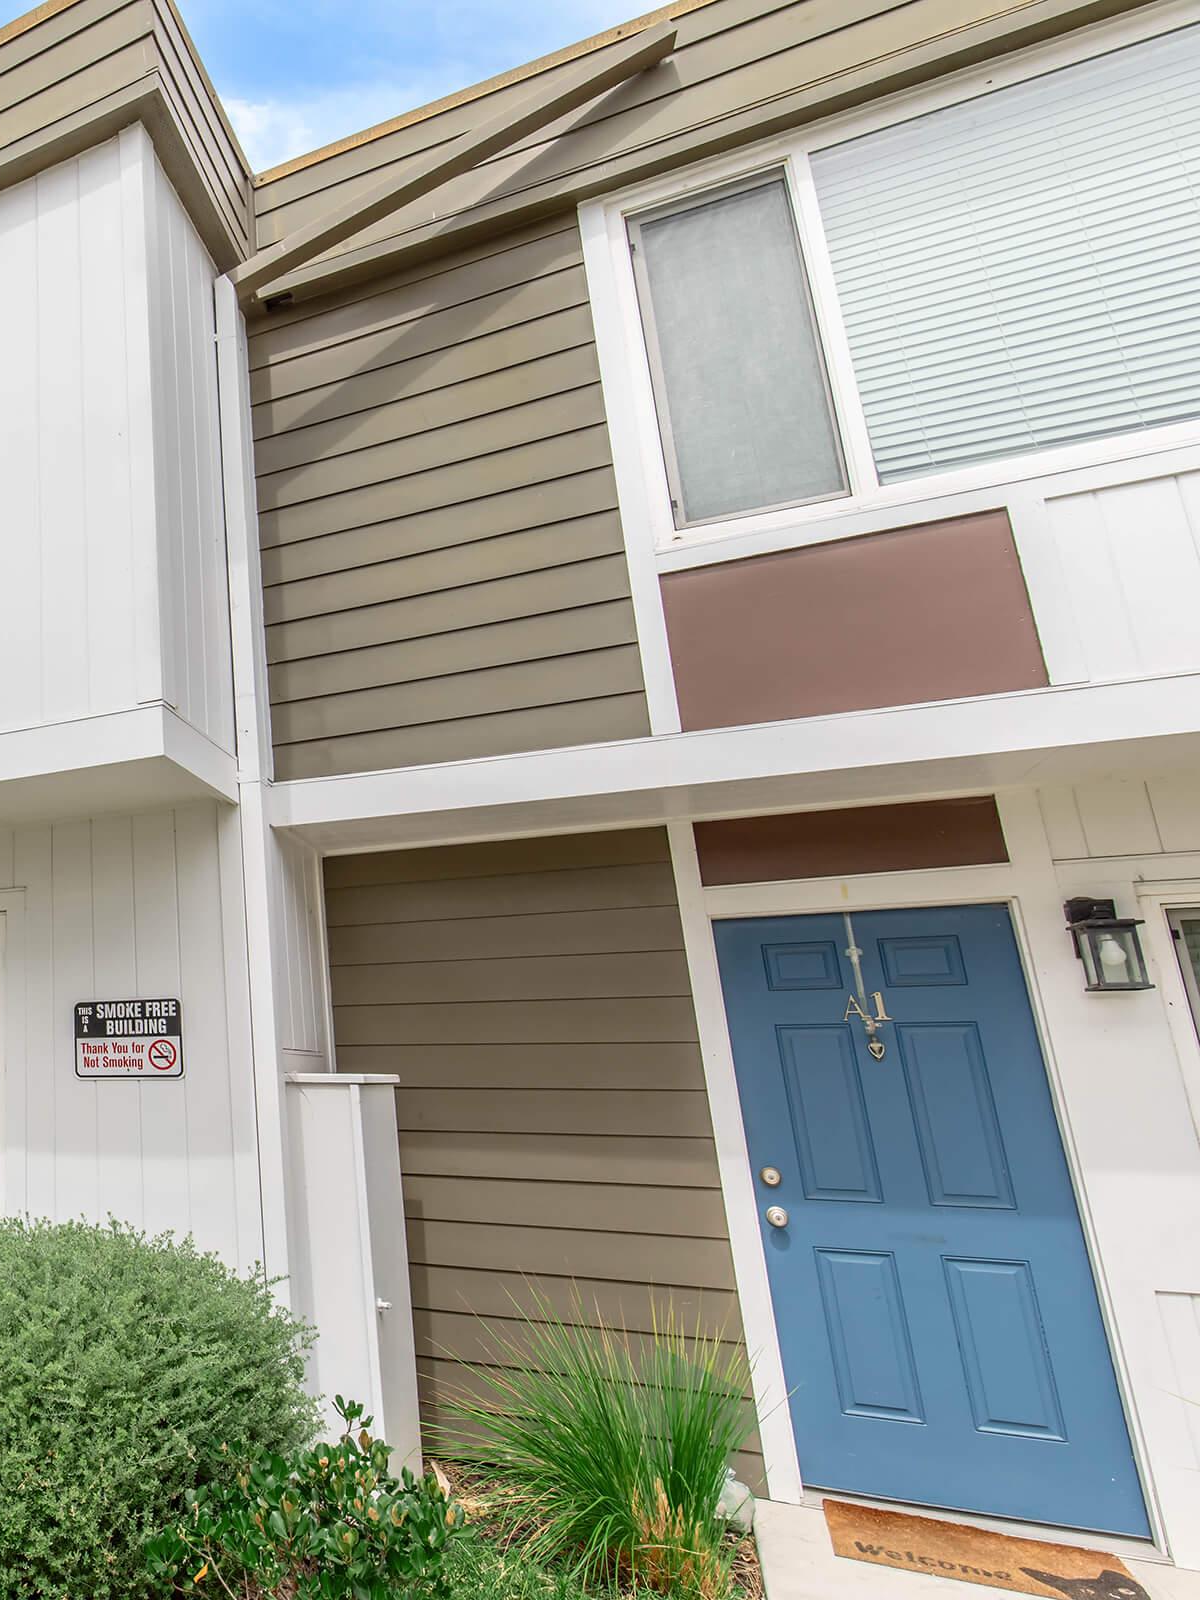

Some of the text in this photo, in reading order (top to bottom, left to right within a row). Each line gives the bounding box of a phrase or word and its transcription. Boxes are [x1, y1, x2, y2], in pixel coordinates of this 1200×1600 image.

[78, 1007, 92, 1015] THIS
[96, 1001, 176, 1019] SMOKE FREE
[843, 991, 893, 1022] A1
[82, 1016, 89, 1024] IS
[106, 1019, 167, 1035] BUILDING
[83, 1024, 89, 1032] A
[81, 1041, 144, 1054] Thank You for
[83, 1055, 143, 1070] Not Smoking
[853, 1540, 1013, 1582] Welcome
